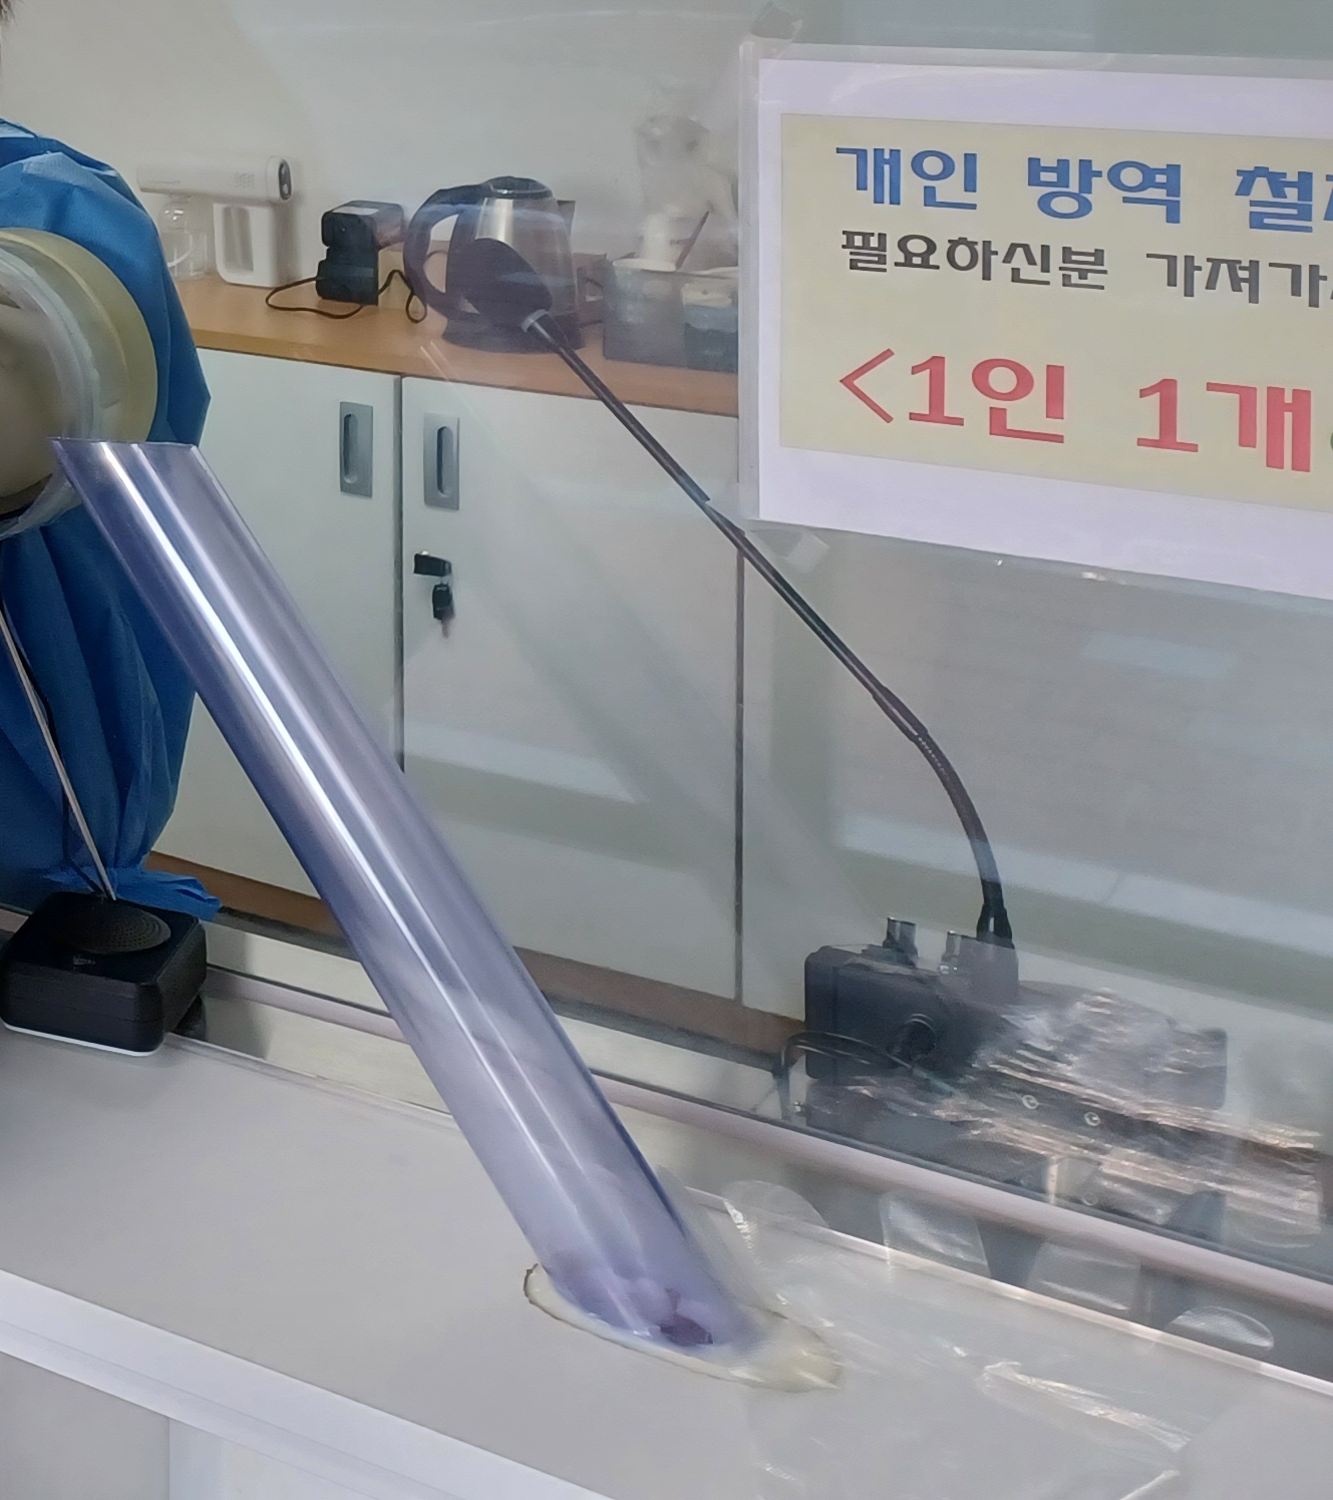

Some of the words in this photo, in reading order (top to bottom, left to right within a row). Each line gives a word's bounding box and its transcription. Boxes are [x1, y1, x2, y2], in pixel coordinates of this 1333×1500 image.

[836, 146, 978, 211] 개인
[1027, 156, 1182, 225] 방역
[1234, 165, 1333, 234] 철
[841, 229, 1108, 290] 필요하신분
[1145, 252, 1333, 309] 가져가
[839, 348, 1066, 444] <1인
